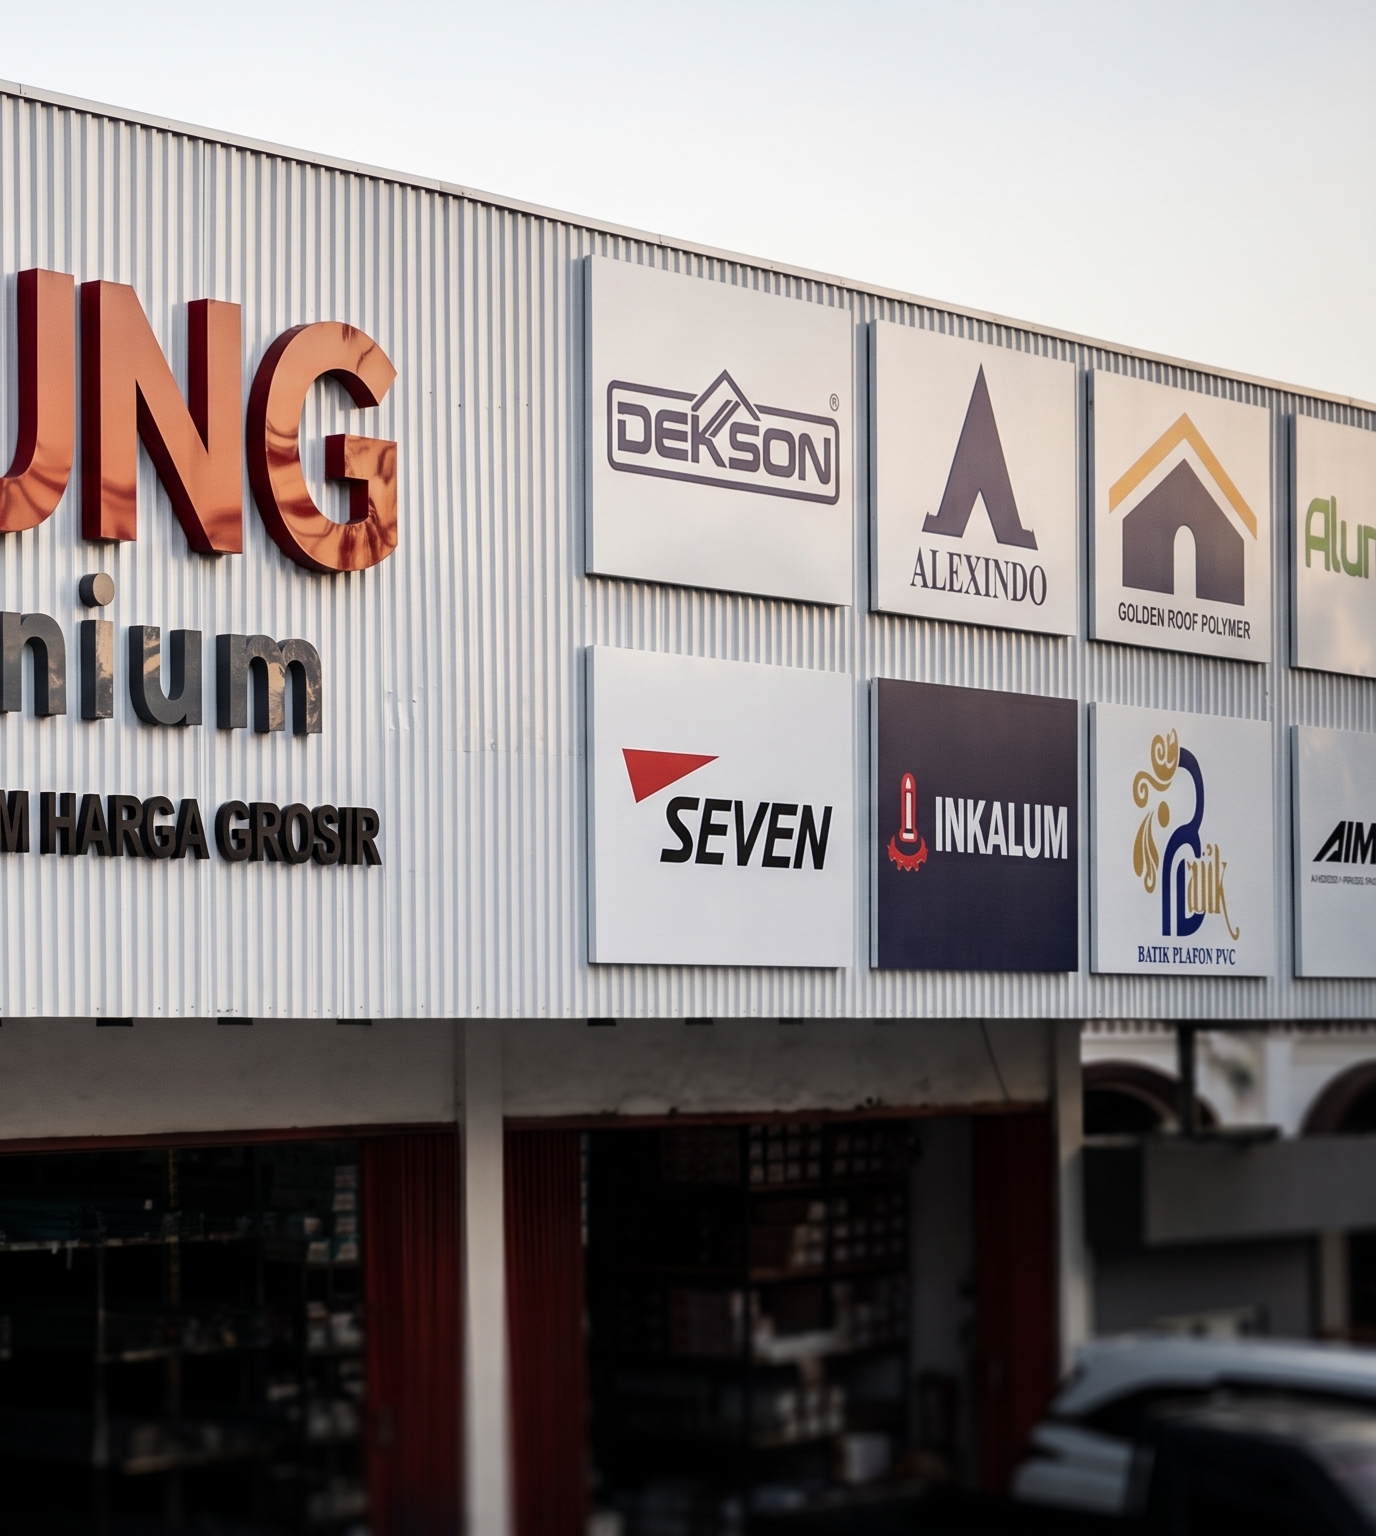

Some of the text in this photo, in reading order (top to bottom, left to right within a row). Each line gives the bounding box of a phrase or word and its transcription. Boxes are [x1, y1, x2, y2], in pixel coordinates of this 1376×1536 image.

[617, 398, 832, 486] DEKSON
[910, 546, 1047, 606] ALEXINDO
[1118, 602, 1251, 639] GOLDEN ROOF POLYMER
[40, 791, 210, 860] HARGA
[214, 799, 383, 867] GROSIR
[660, 796, 833, 870] SEVEN
[935, 796, 1068, 860] INKALUM
[1138, 945, 1236, 965] BATIK PLAFON PVC
